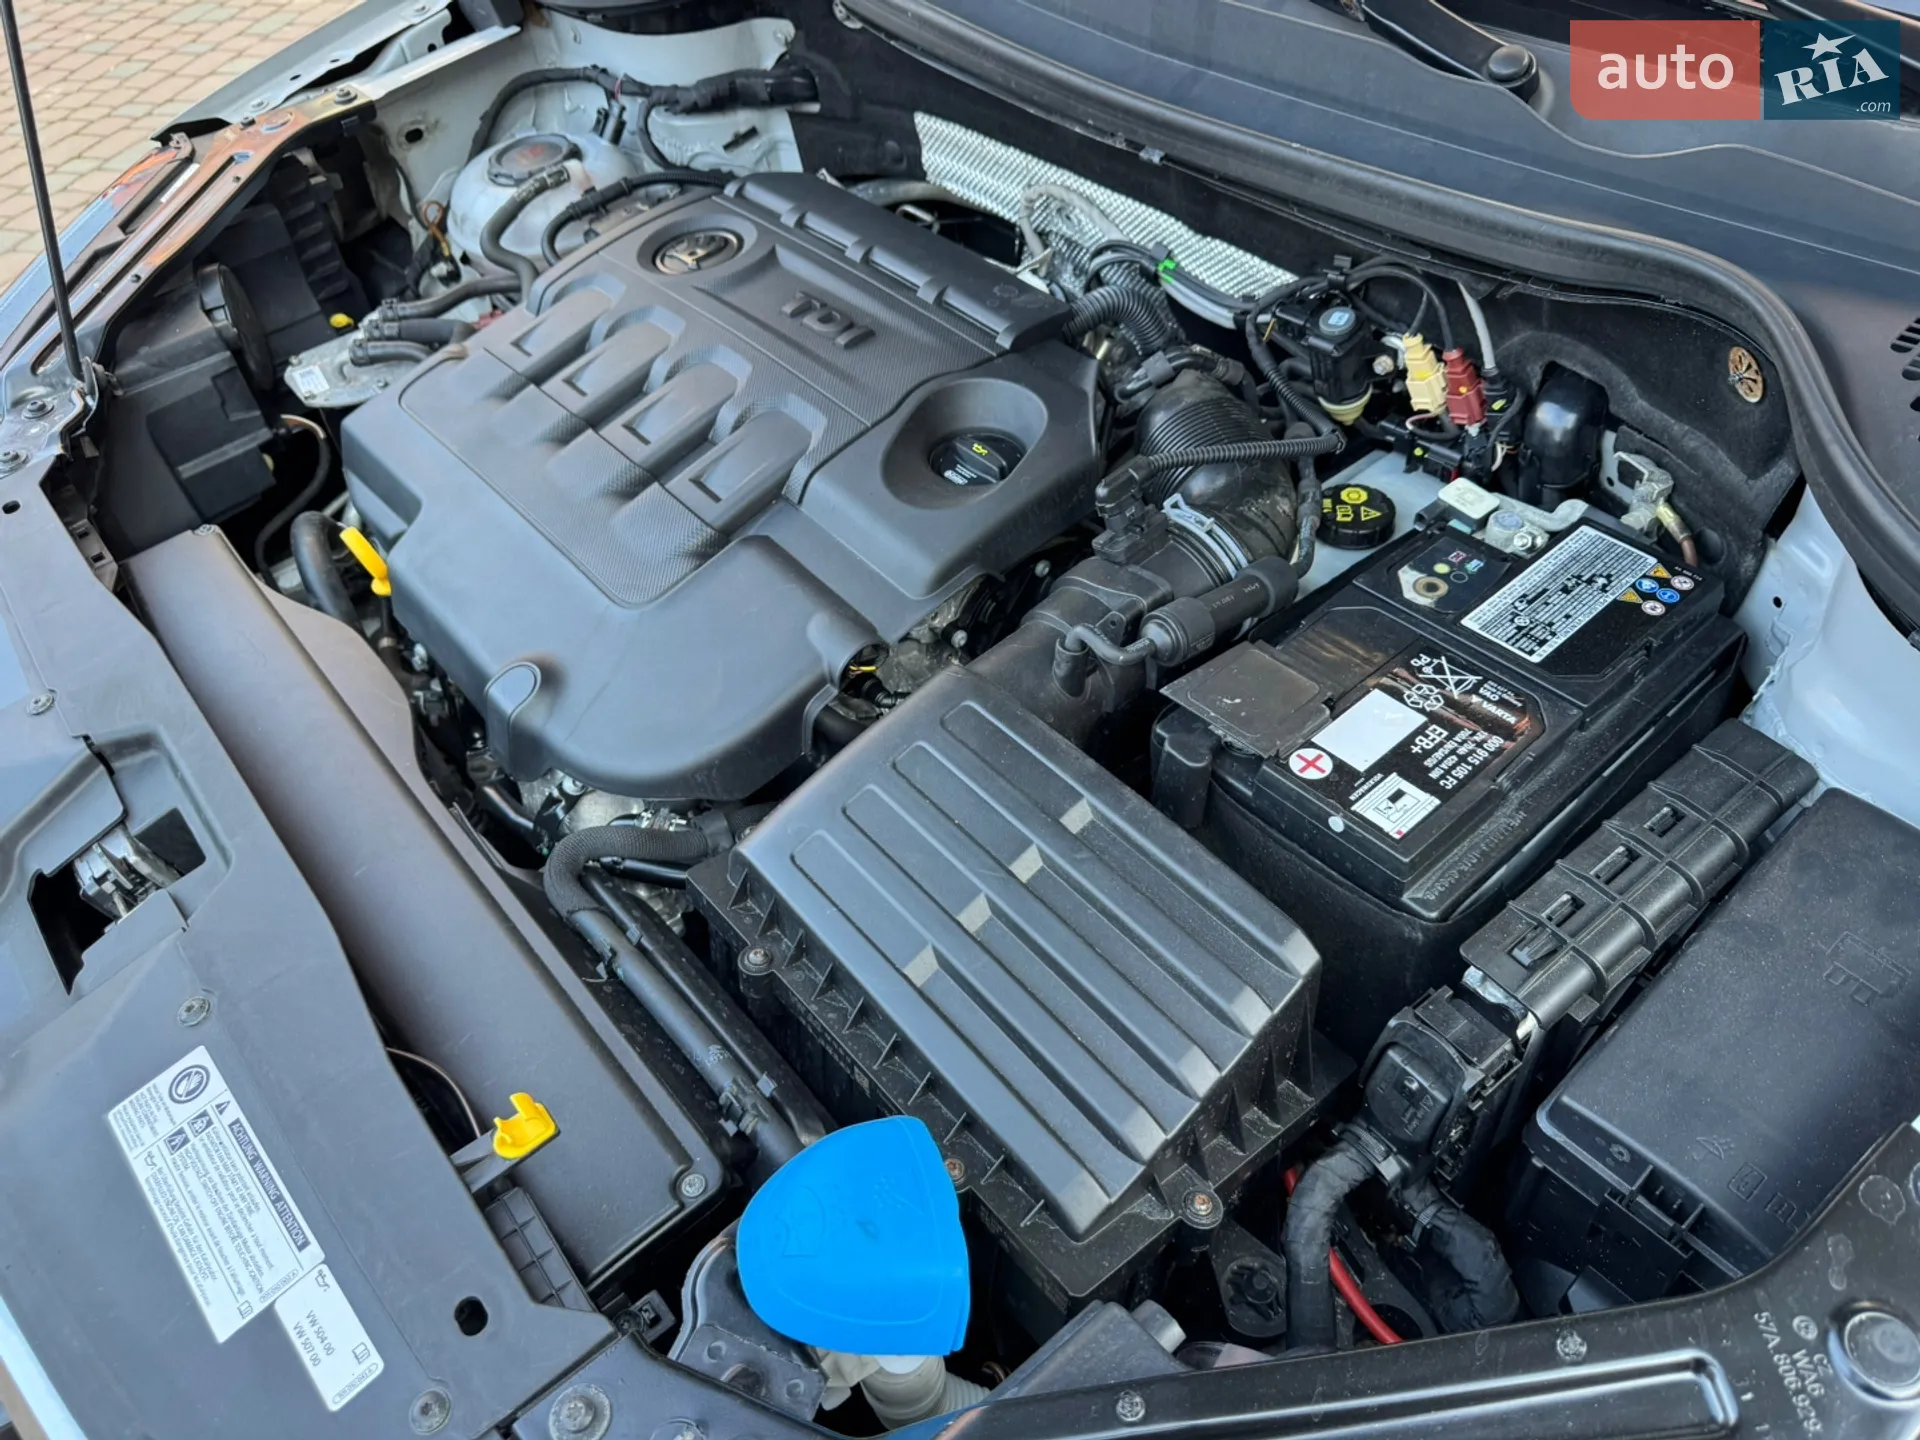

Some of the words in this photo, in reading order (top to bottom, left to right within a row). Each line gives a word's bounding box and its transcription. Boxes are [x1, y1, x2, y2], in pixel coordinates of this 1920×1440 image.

[781, 291, 876, 350] TDI
[1410, 653, 1431, 667] Pb
[1482, 701, 1517, 724] VARTA
[1410, 724, 1449, 753] EFB+
[1483, 735, 1504, 752] 000
[1467, 748, 1489, 765] 915
[1439, 775, 1458, 789] FC
[1451, 763, 1472, 779] 105
[230, 1119, 258, 1161] ACHTUNG
[252, 1158, 280, 1200] WARNING
[273, 1197, 306, 1246] ATTENTION
[291, 1320, 307, 1340] VW
[300, 1335, 315, 1355] 507
[308, 1350, 322, 1368] 00
[304, 1308, 320, 1329] VW
[312, 1324, 329, 1345] 504
[321, 1339, 336, 1358] 00
